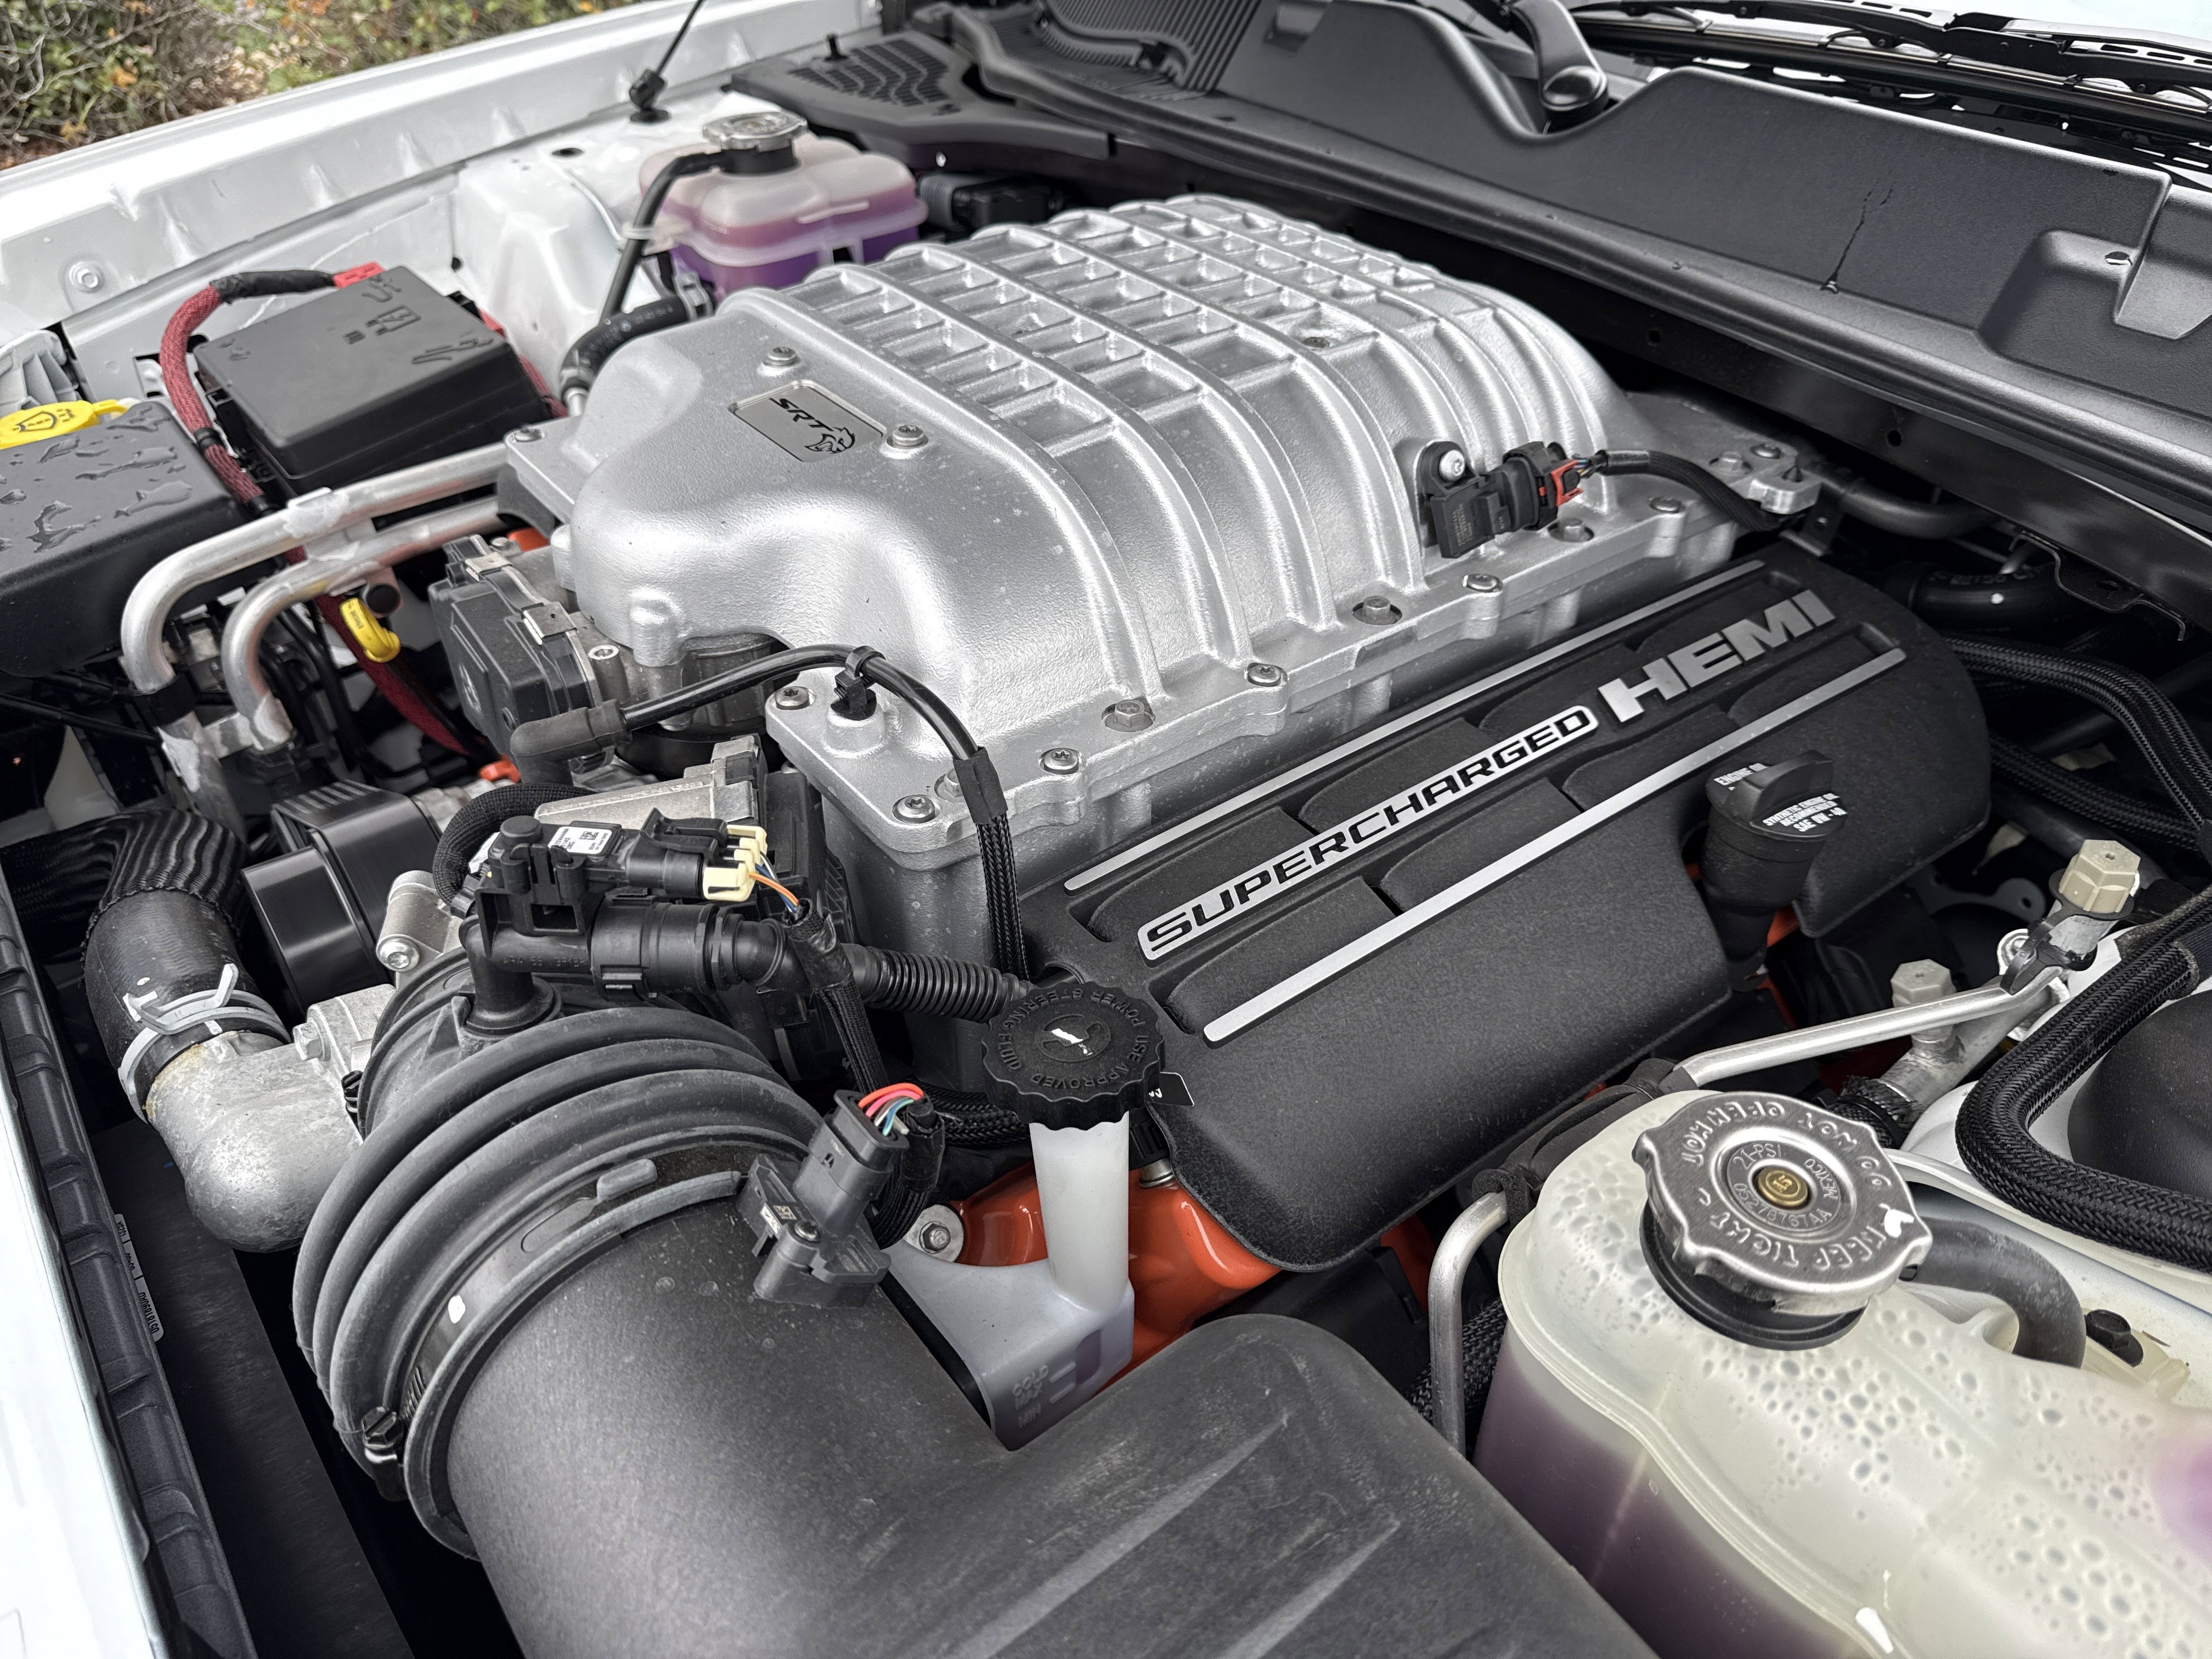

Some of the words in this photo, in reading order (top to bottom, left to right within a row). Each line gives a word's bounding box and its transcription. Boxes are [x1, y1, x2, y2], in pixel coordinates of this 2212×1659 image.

[769, 397, 834, 431] SRT
[1147, 709, 1590, 952] SUPERCHARGED
[1599, 590, 1835, 723] HEMI
[1713, 768, 1754, 786] ENGINE
[1748, 763, 1769, 772] OIL
[1762, 805, 1803, 826] SYNTHETIC
[1797, 796, 1827, 809] ENGINE
[1793, 819, 1818, 832] SAE
[1003, 988, 1084, 1029] STEERING
[1090, 990, 1146, 1027] POWER
[998, 1033, 1022, 1070] FLUID
[1128, 1035, 1149, 1063] USE
[1030, 1062, 1129, 1089] APPROVED
[1708, 1101, 1785, 1126] OPEN
[1798, 1112, 1857, 1150] NOT
[1681, 1121, 1711, 1165] HOT
[1804, 1158, 1838, 1199] MEXICO
[1734, 1183, 1832, 1227] 05278767AA
[1710, 1212, 1799, 1268] TIGHT
[1815, 1225, 1887, 1271] KEEP
[1012, 1365, 1048, 1396] COLD
